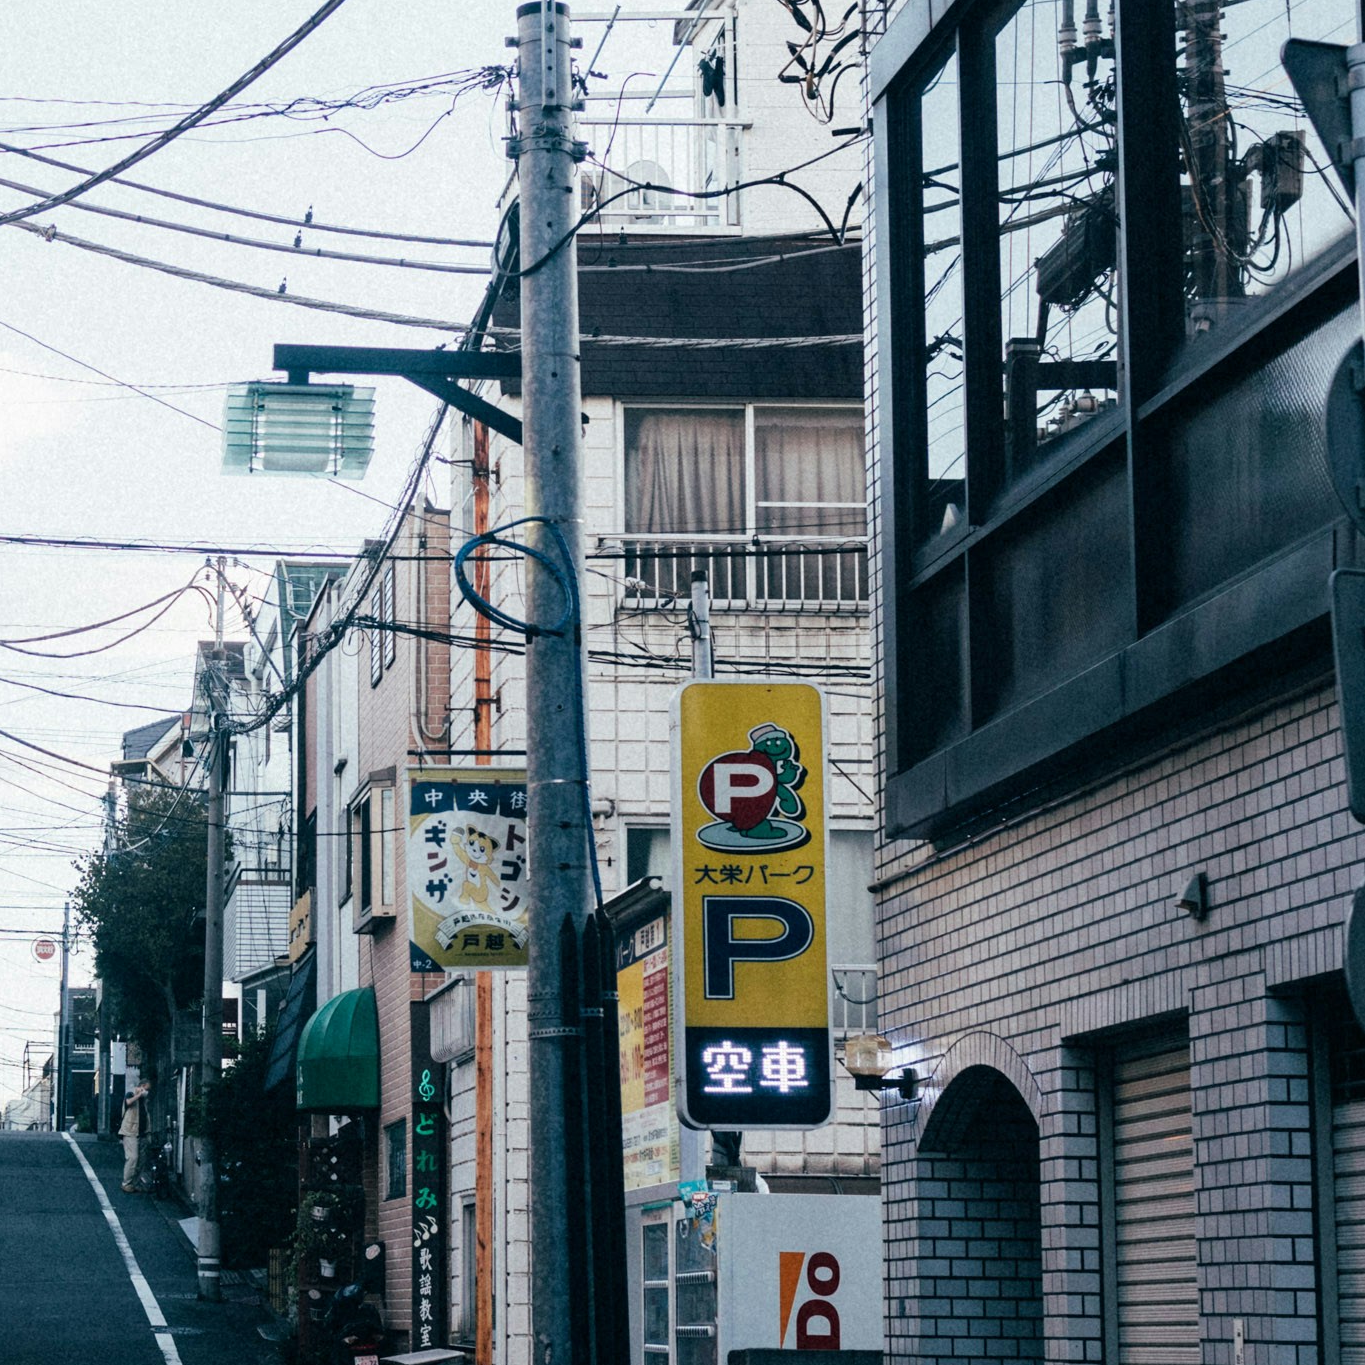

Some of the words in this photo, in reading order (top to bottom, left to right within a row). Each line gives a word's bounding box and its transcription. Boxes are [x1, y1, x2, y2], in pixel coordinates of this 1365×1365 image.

[713, 763, 775, 814] P
[424, 819, 453, 904] ギンザ
[500, 823, 527, 912] トゴシ
[694, 862, 815, 886] 大栄パーク
[412, 958, 433, 970] 中-2
[462, 933, 505, 951] 戸越
[703, 895, 815, 1001] P
[702, 1040, 809, 1095] 空車
[415, 1112, 438, 1209] どれみ
[419, 1248, 432, 1348] 歌謡教室
